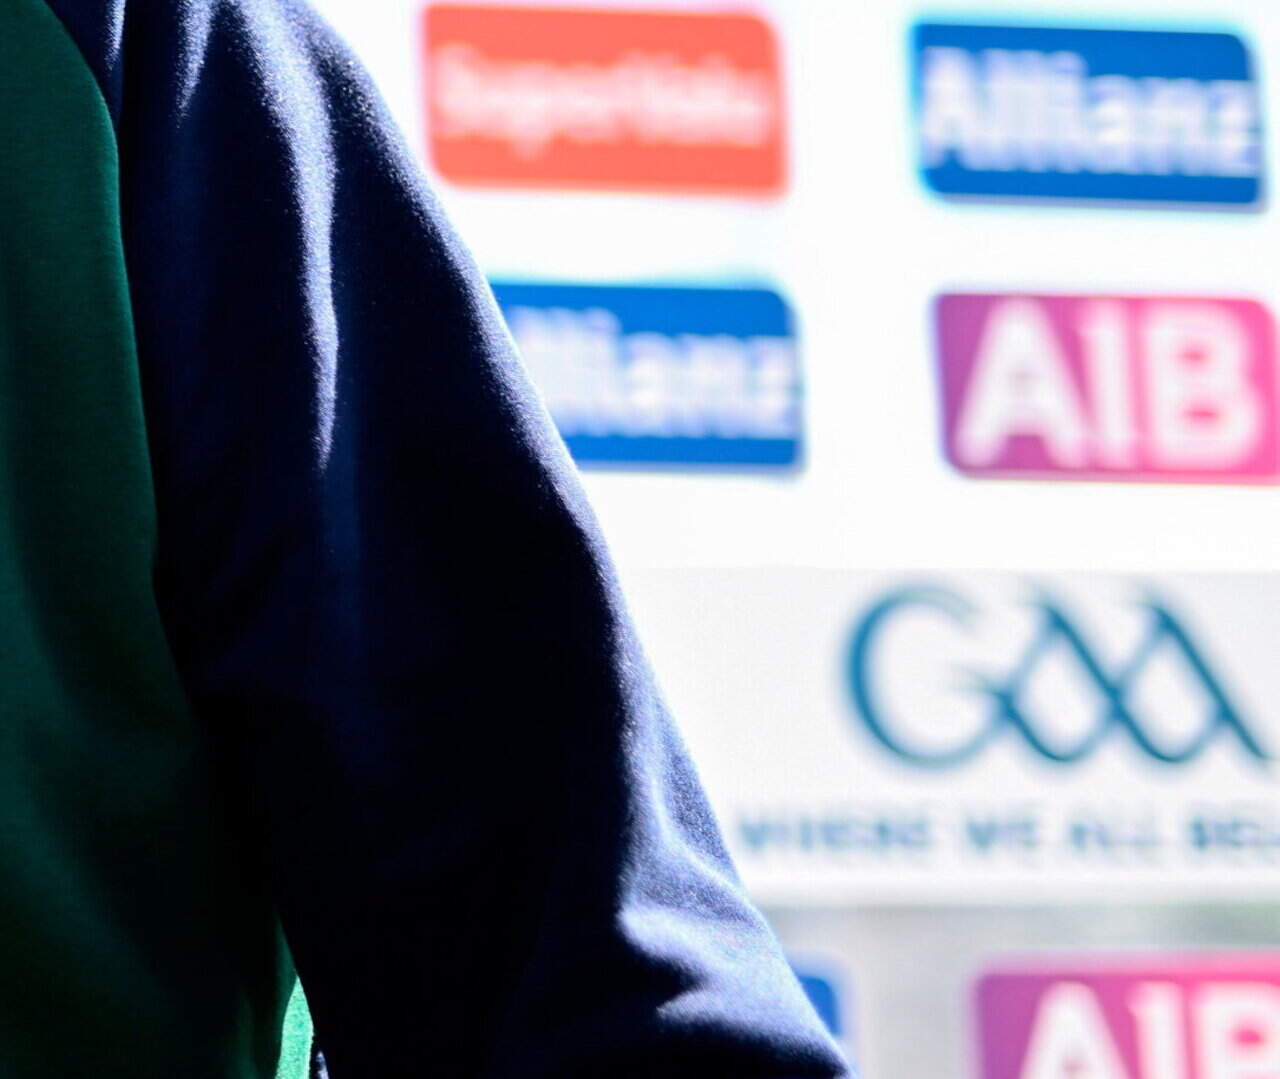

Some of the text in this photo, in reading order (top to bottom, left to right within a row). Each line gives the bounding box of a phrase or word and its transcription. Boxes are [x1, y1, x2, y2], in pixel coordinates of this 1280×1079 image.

[918, 46, 1264, 178] Allianz
[504, 306, 796, 438] llianz
[952, 298, 1262, 466] AIB
[842, 584, 1272, 772] GAA
